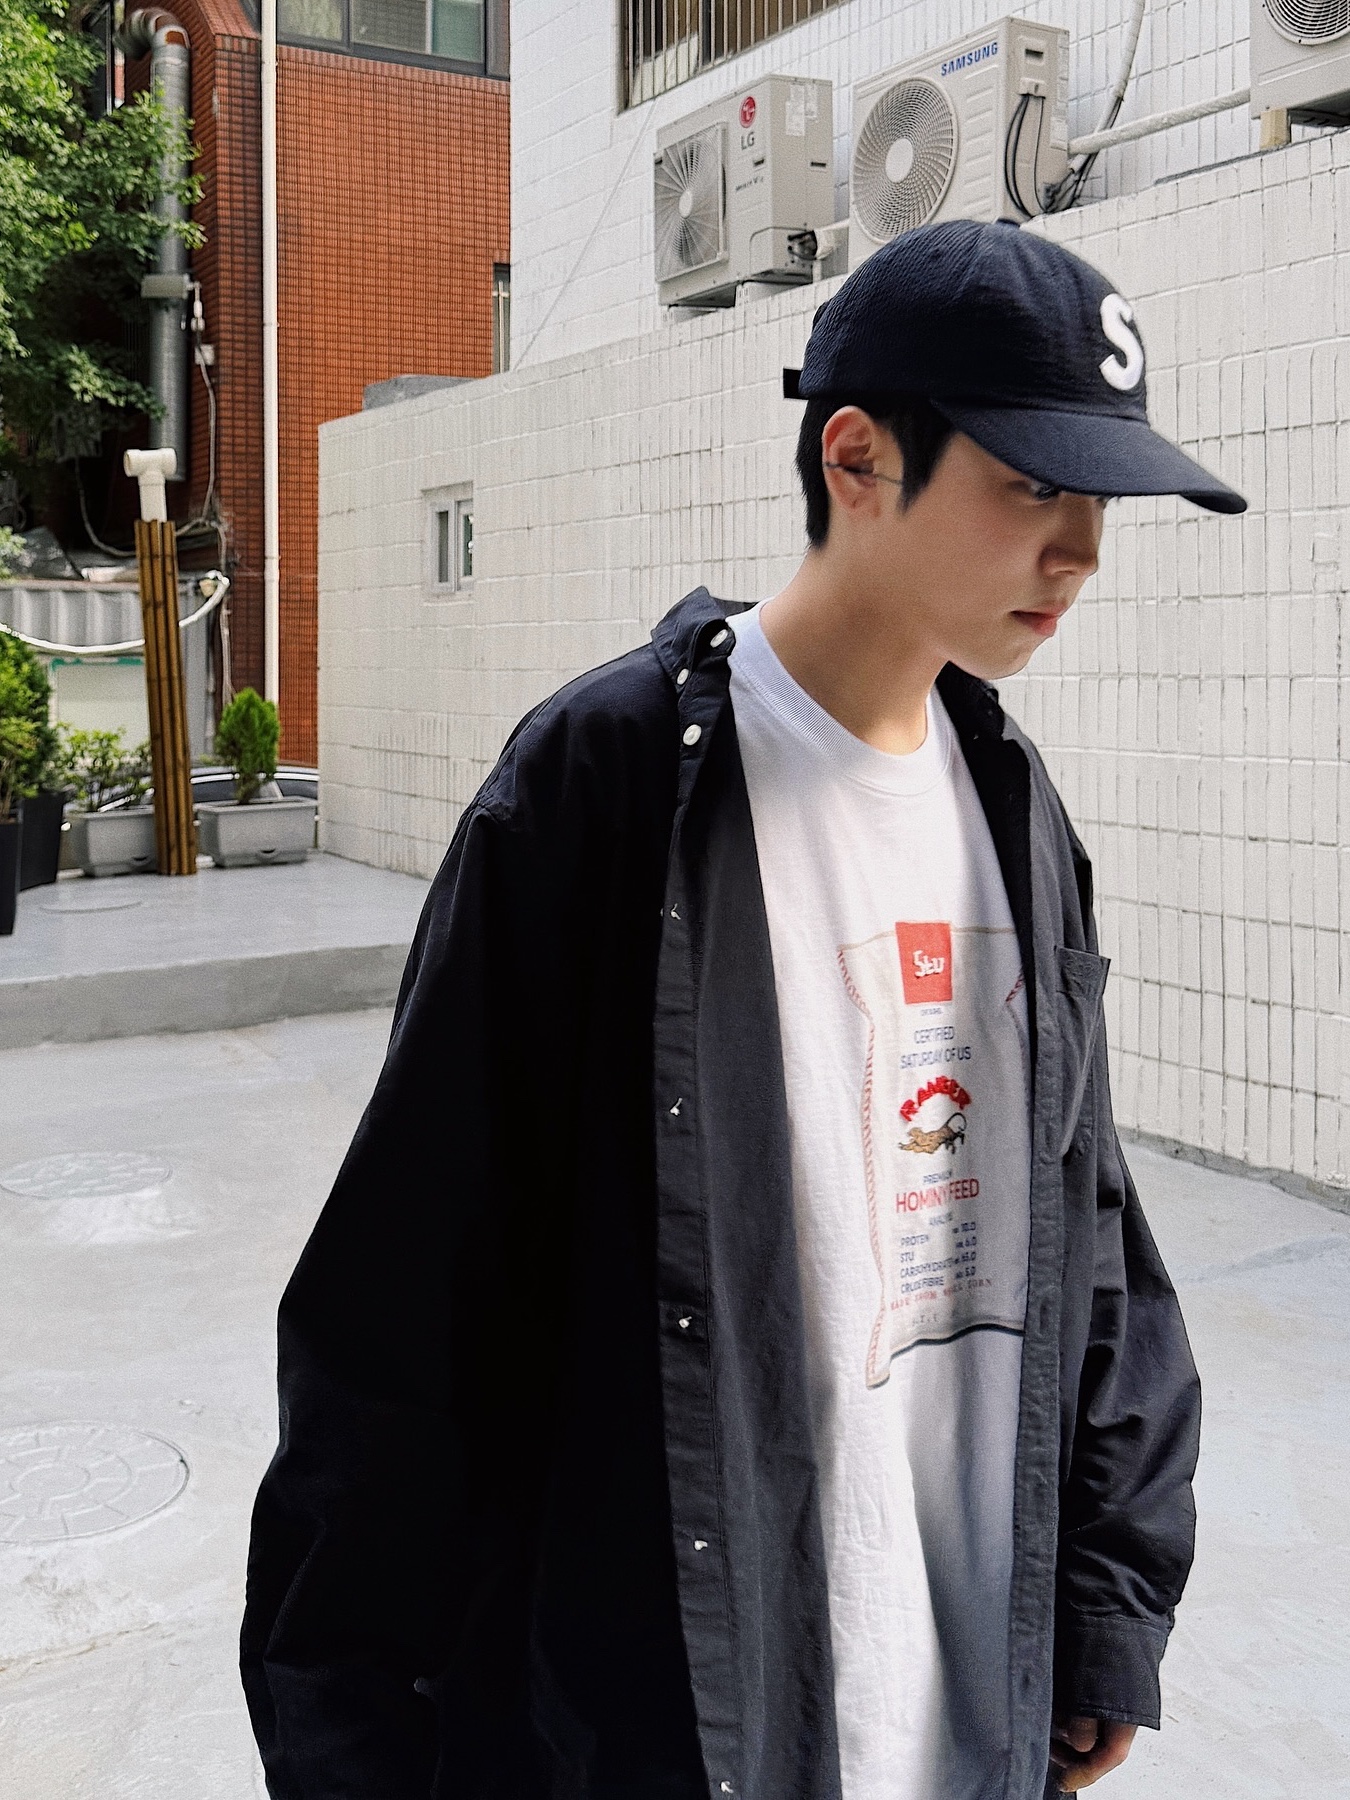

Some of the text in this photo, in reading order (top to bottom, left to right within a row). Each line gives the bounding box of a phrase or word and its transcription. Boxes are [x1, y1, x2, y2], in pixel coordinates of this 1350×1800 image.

[940, 41, 998, 77] SAMSUNG
[740, 131, 754, 150] LG
[1098, 292, 1144, 391] S
[944, 1047, 956, 1062] OF
[957, 1046, 972, 1060] US
[949, 1178, 980, 1201] FEED
